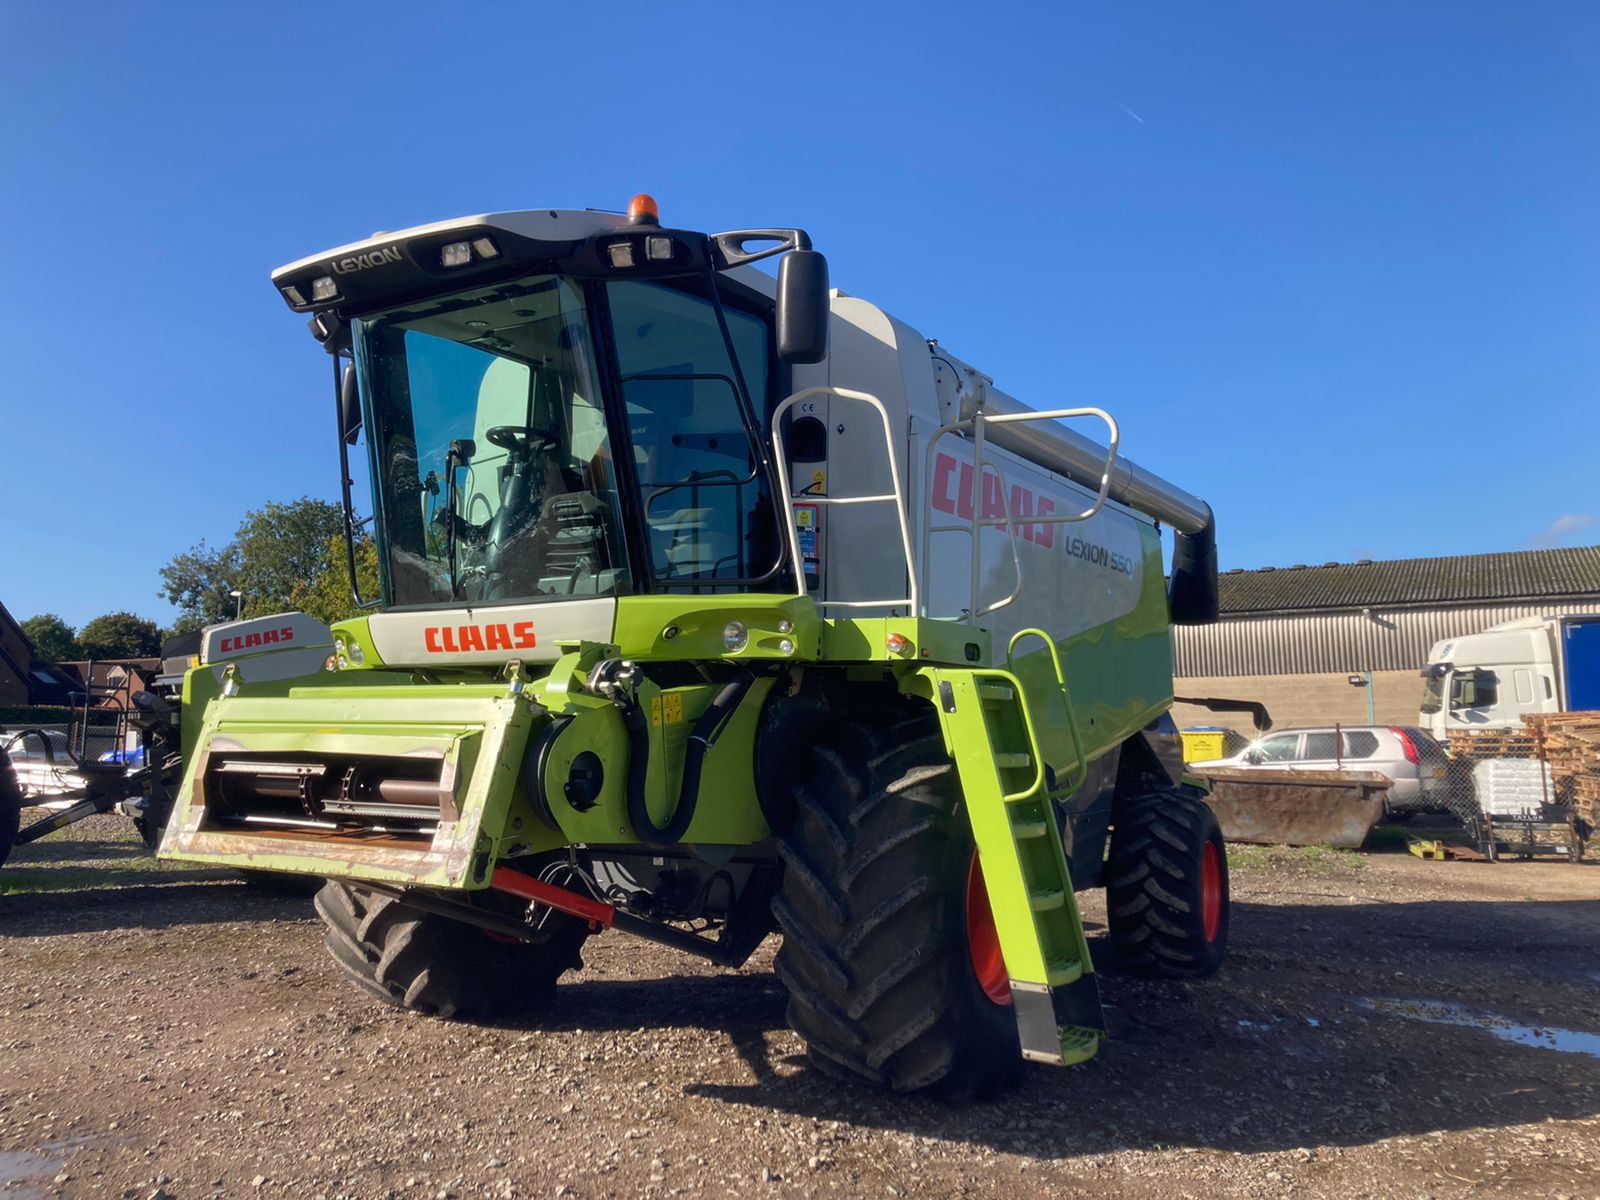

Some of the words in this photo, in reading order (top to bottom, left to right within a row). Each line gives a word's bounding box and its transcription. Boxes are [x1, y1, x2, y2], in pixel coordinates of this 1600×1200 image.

[332, 246, 402, 274] LEXION
[932, 452, 1055, 549] CLAAS
[1065, 535, 1109, 568] LEXION
[1110, 551, 1133, 576] 550
[221, 627, 294, 653] CLAAS
[424, 621, 536, 653] CLAAS
